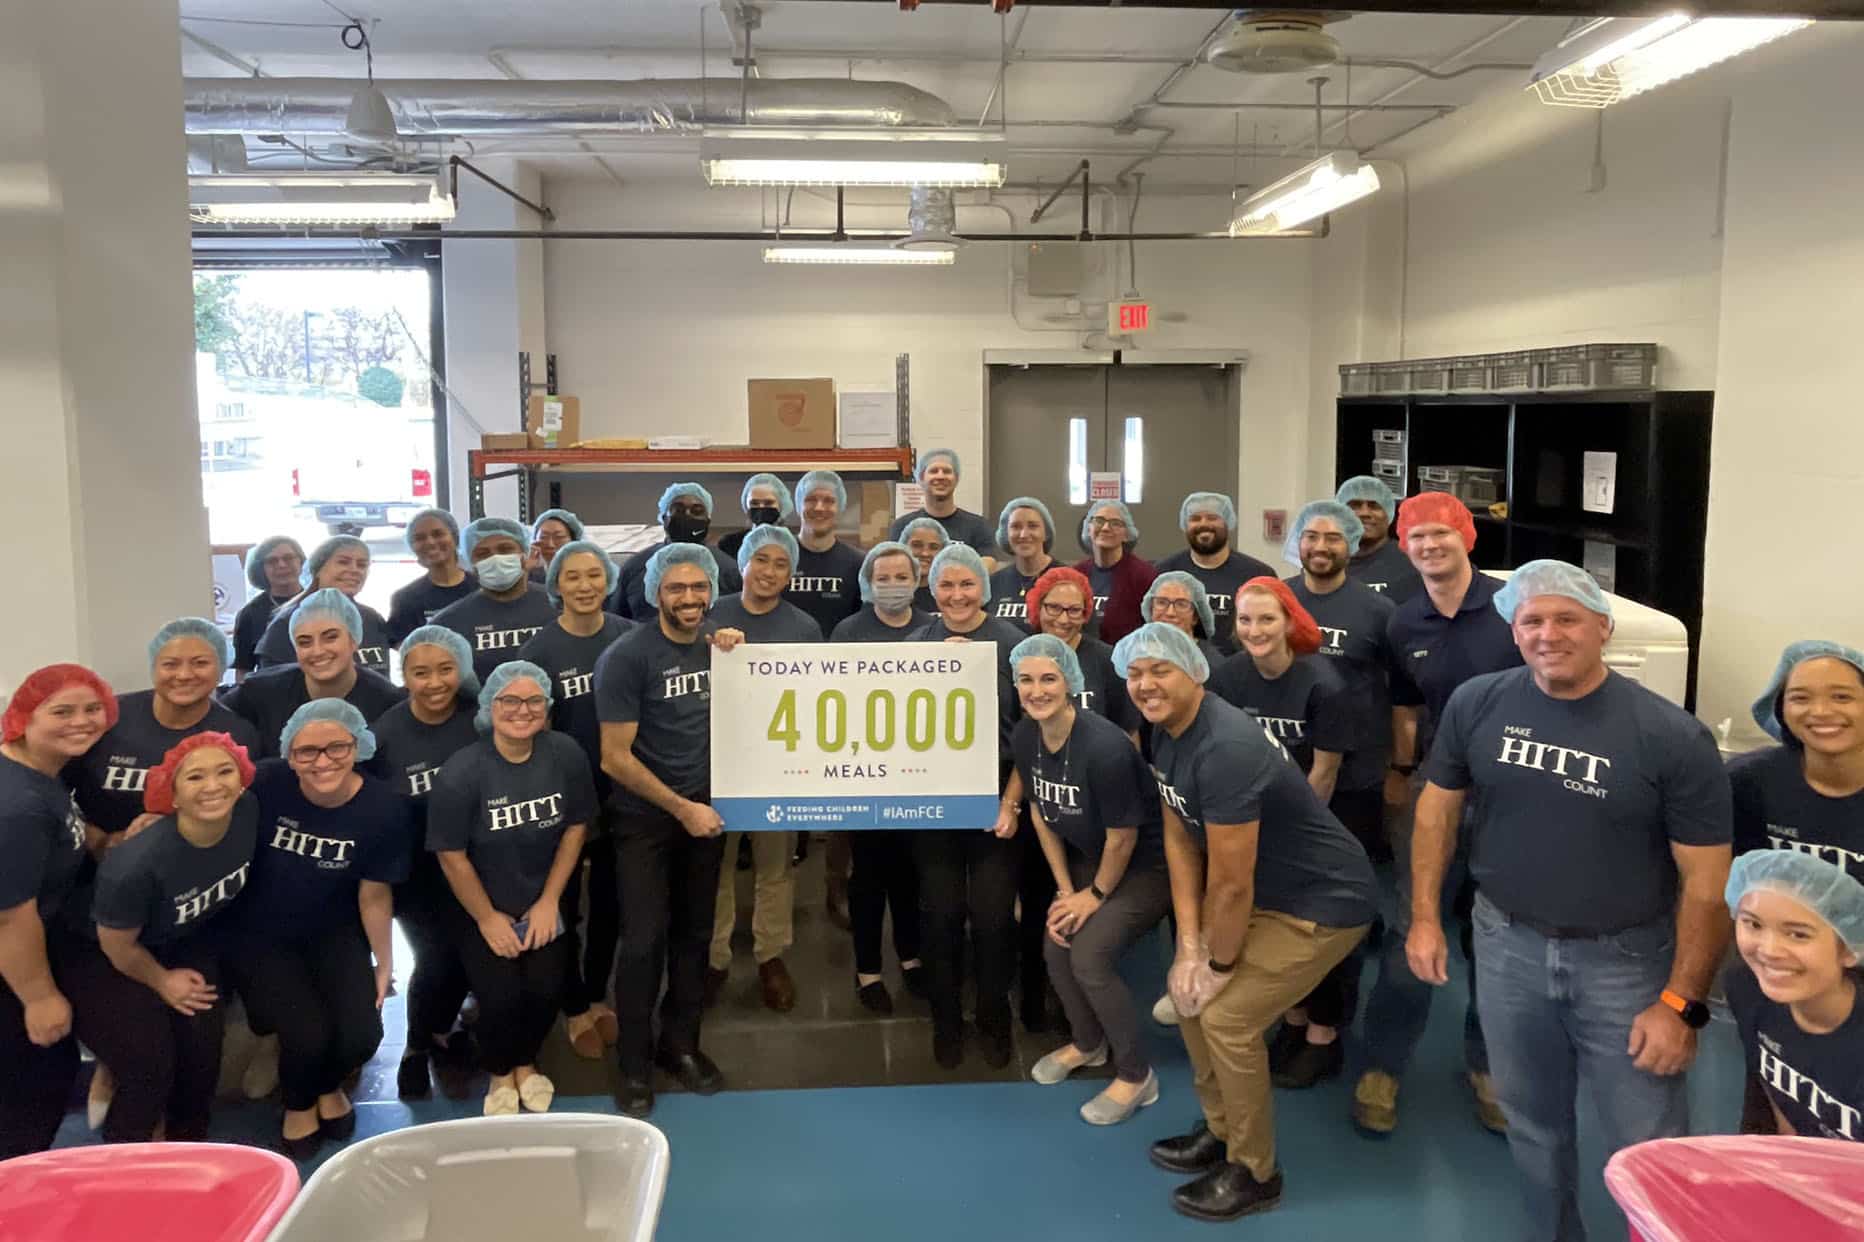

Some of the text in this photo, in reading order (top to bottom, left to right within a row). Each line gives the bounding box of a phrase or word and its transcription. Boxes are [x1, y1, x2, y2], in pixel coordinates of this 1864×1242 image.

[1120, 304, 1150, 330] EXIT
[790, 576, 842, 592] HITT
[995, 603, 1028, 618] HIT
[358, 647, 383, 664] TT
[747, 660, 962, 675] TODAY WE PACKAGED
[560, 672, 593, 699] HI
[767, 688, 976, 755] 40,000
[1256, 716, 1306, 738] ITT
[1504, 725, 1533, 738] MAKE
[824, 764, 887, 778] MEALS
[1497, 736, 1611, 784] HITT
[101, 766, 149, 791] HI
[1563, 778, 1609, 799] COUNT
[1033, 775, 1080, 807] HITT
[488, 792, 562, 831] HITT
[826, 805, 869, 813] CHILDREN
[883, 806, 944, 819] #IAmFCE
[269, 825, 355, 860] HITT
[174, 861, 250, 925] HITT
[1759, 1044, 1861, 1141] HITT
